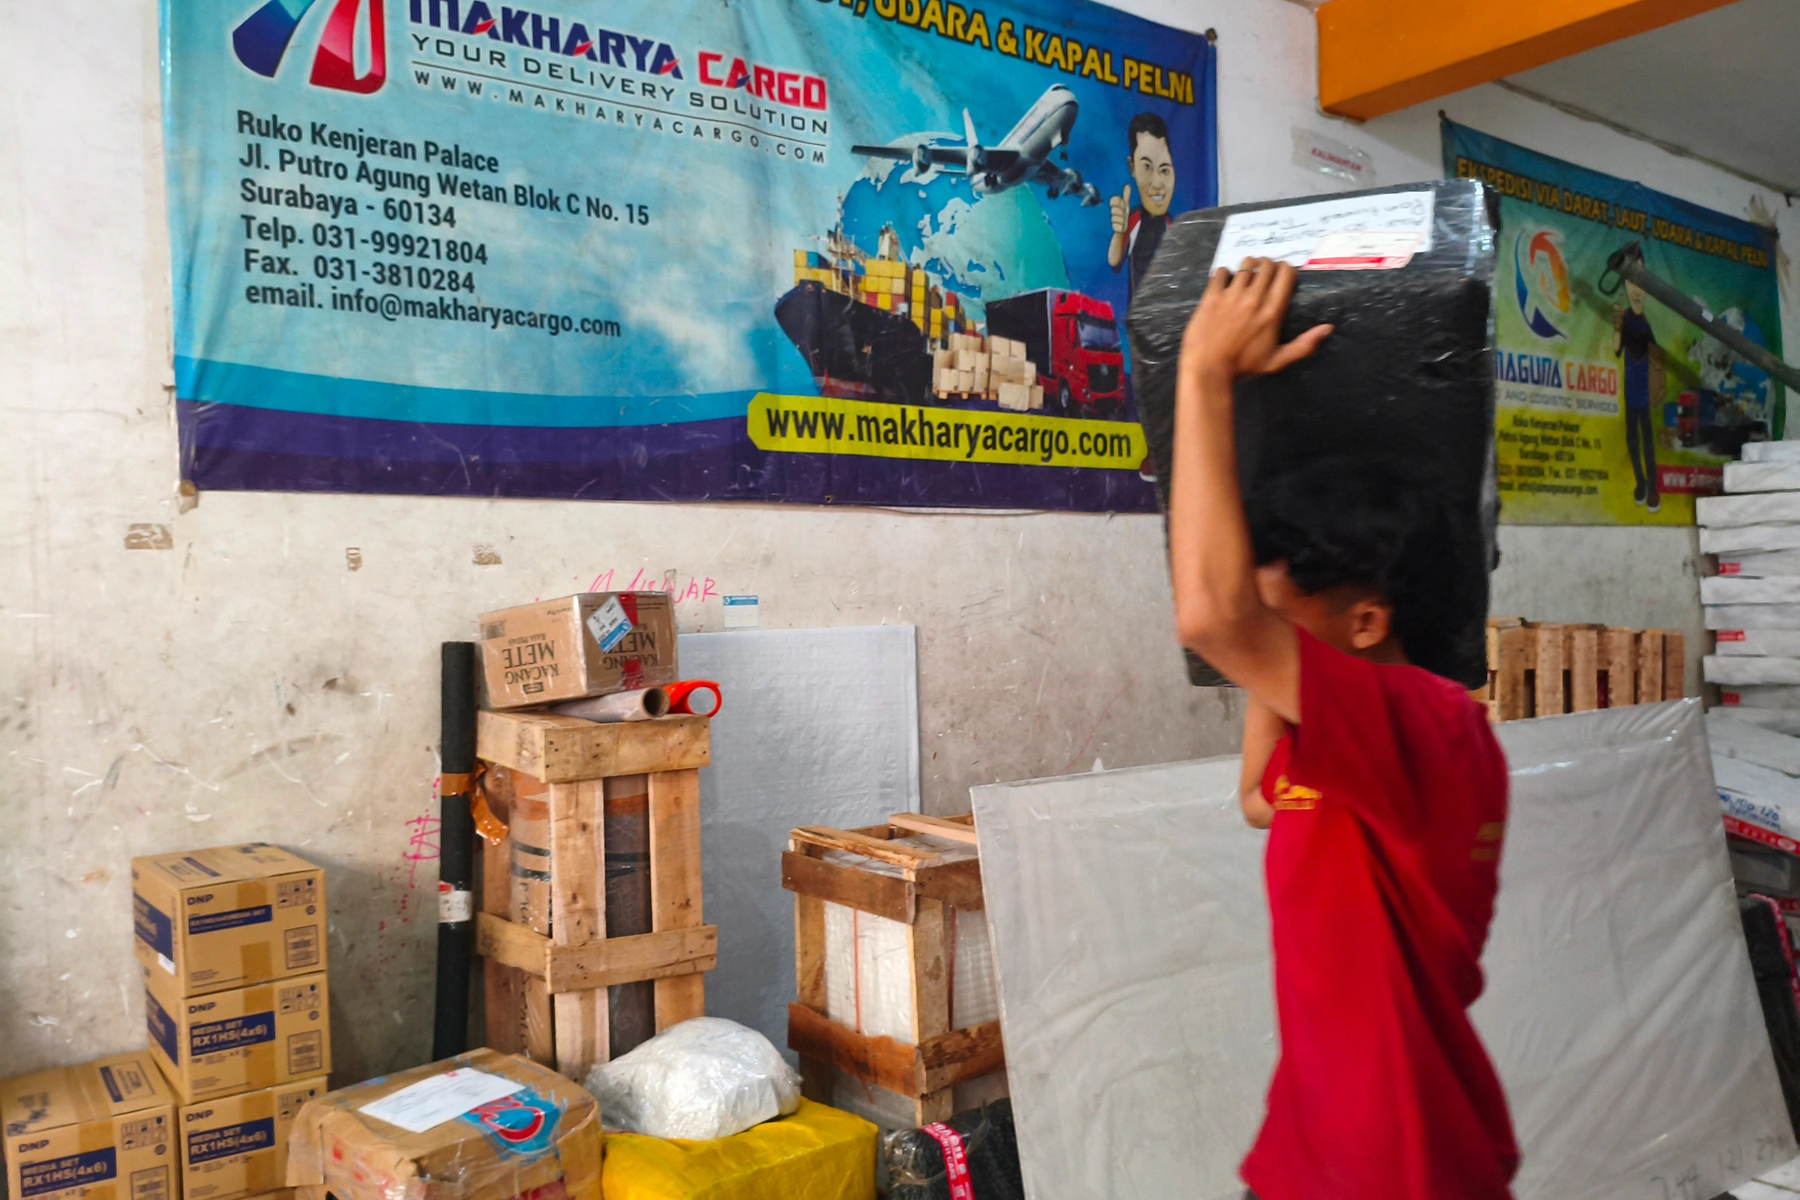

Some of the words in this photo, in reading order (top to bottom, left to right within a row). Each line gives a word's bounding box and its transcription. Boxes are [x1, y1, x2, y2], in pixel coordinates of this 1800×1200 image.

[410, 0, 684, 79] MAKHARYA
[697, 51, 827, 111] CARGO
[874, 0, 992, 49] UDARA
[996, 20, 1018, 56] &
[1024, 27, 1119, 85] KAPAL
[1123, 57, 1195, 105] PELNI
[411, 33, 507, 68] YOUR
[523, 57, 675, 102] DELIVERY
[689, 91, 828, 135] SOLUTION
[237, 109, 303, 142] Ruko
[310, 121, 417, 161] Kenjeran
[424, 140, 499, 173] Palace
[414, 70, 825, 164] WWW.MAKHARYACARGO.COM
[239, 142, 270, 170] Jl.
[278, 148, 348, 181] Putro
[355, 161, 431, 198] Agung
[436, 172, 508, 204] Wetan
[513, 183, 561, 212] Blok
[566, 193, 580, 215] C
[585, 196, 619, 222] No.
[625, 203, 650, 226] 15
[240, 177, 358, 219] Surabaya
[383, 197, 457, 228] 60134
[240, 214, 304, 249] Telp.
[312, 222, 489, 265] 031-99921804
[243, 248, 299, 276] Fax.
[313, 255, 476, 294] 031-3810284
[245, 282, 323, 309] email.
[331, 286, 622, 338] info@makharyacargo.com
[1565, 361, 1618, 396] CARGO
[766, 407, 1133, 463] www.makharyacargo.com
[502, 639, 555, 670] METE
[504, 663, 559, 685] KACANG
[187, 893, 215, 906] DNP
[188, 1001, 217, 1015] DNP
[186, 1109, 214, 1123] DNP
[18, 1139, 50, 1154] DNP
